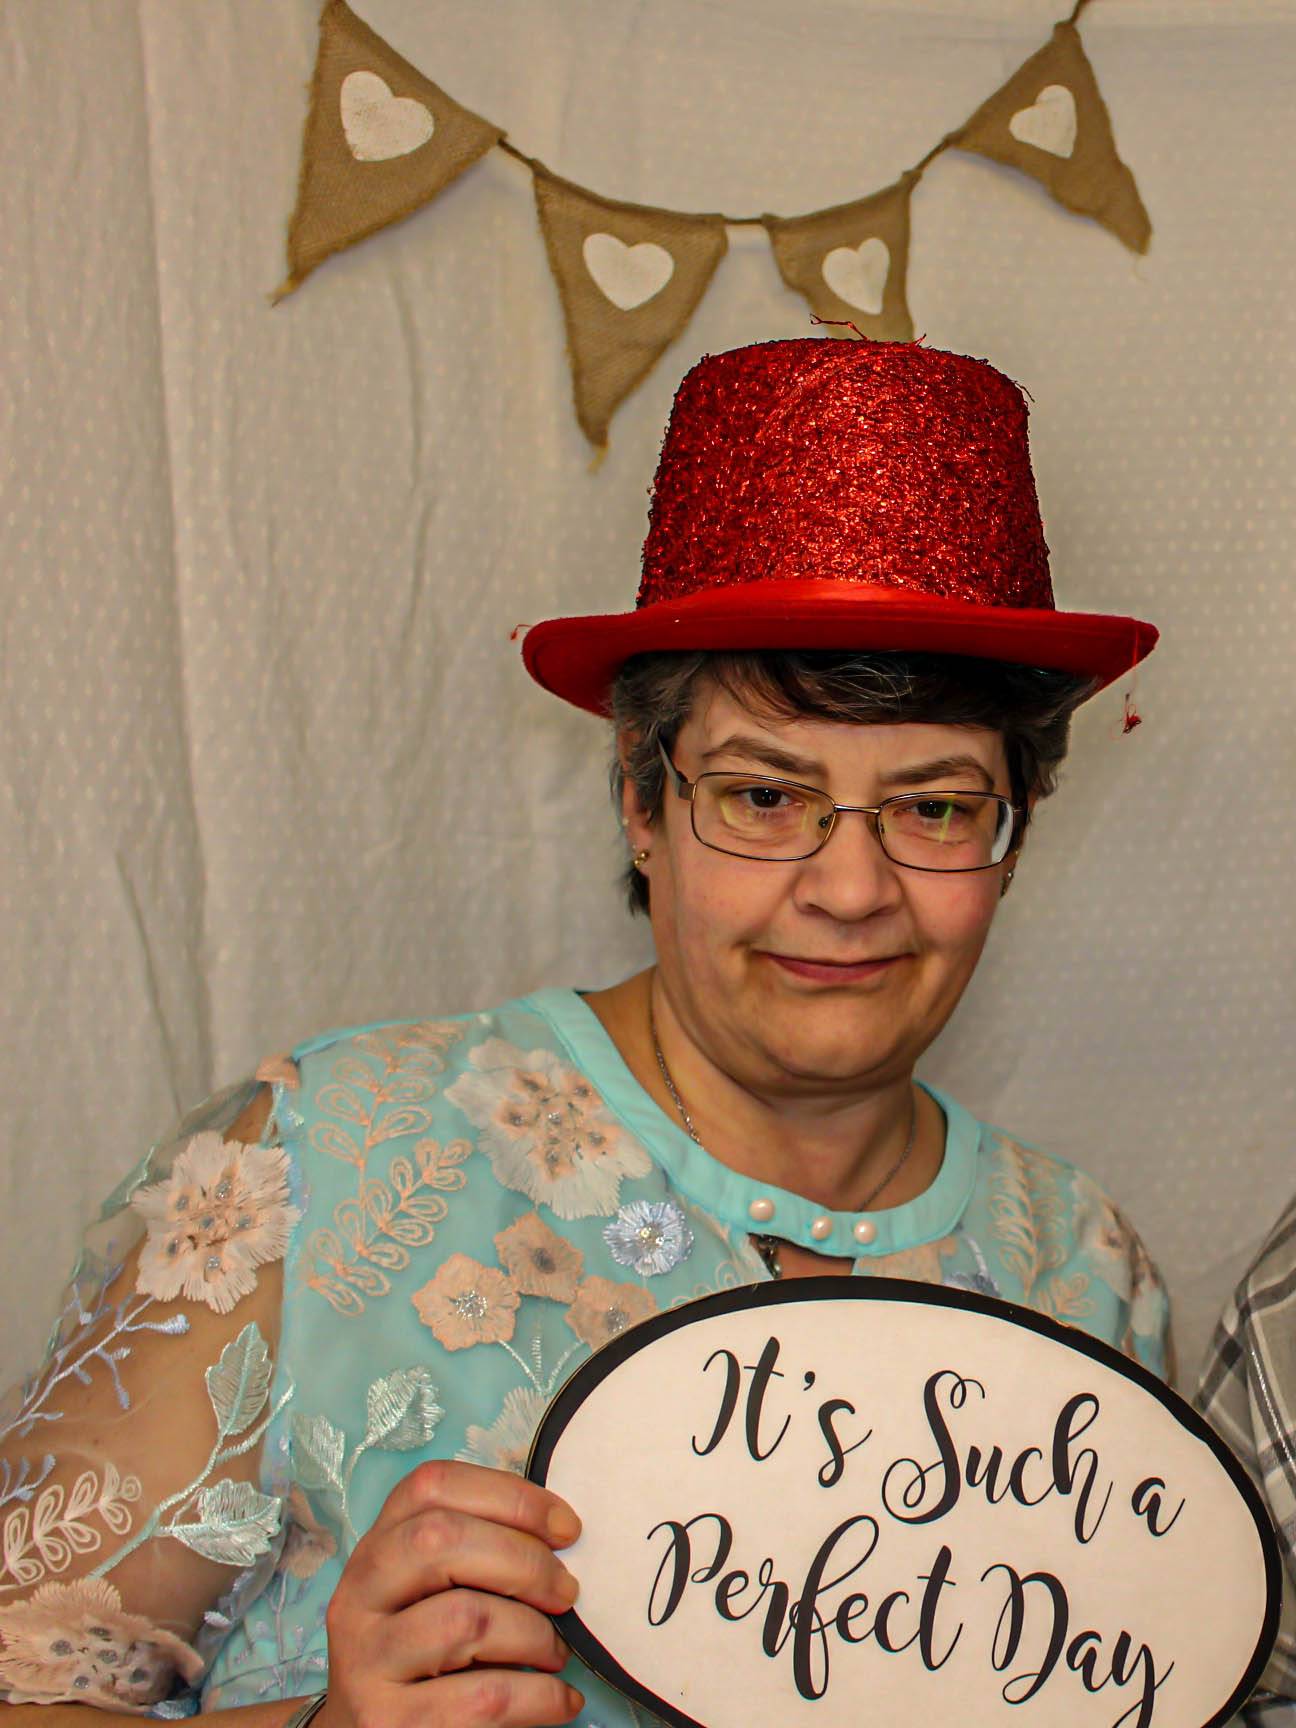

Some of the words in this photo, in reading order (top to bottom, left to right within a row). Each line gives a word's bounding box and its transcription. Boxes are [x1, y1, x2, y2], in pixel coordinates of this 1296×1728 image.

[691, 1336, 873, 1489] It's
[881, 1369, 1114, 1545] Such
[1131, 1477, 1186, 1538] a
[646, 1513, 963, 1701] Perfect
[980, 1563, 1175, 1728] Day
